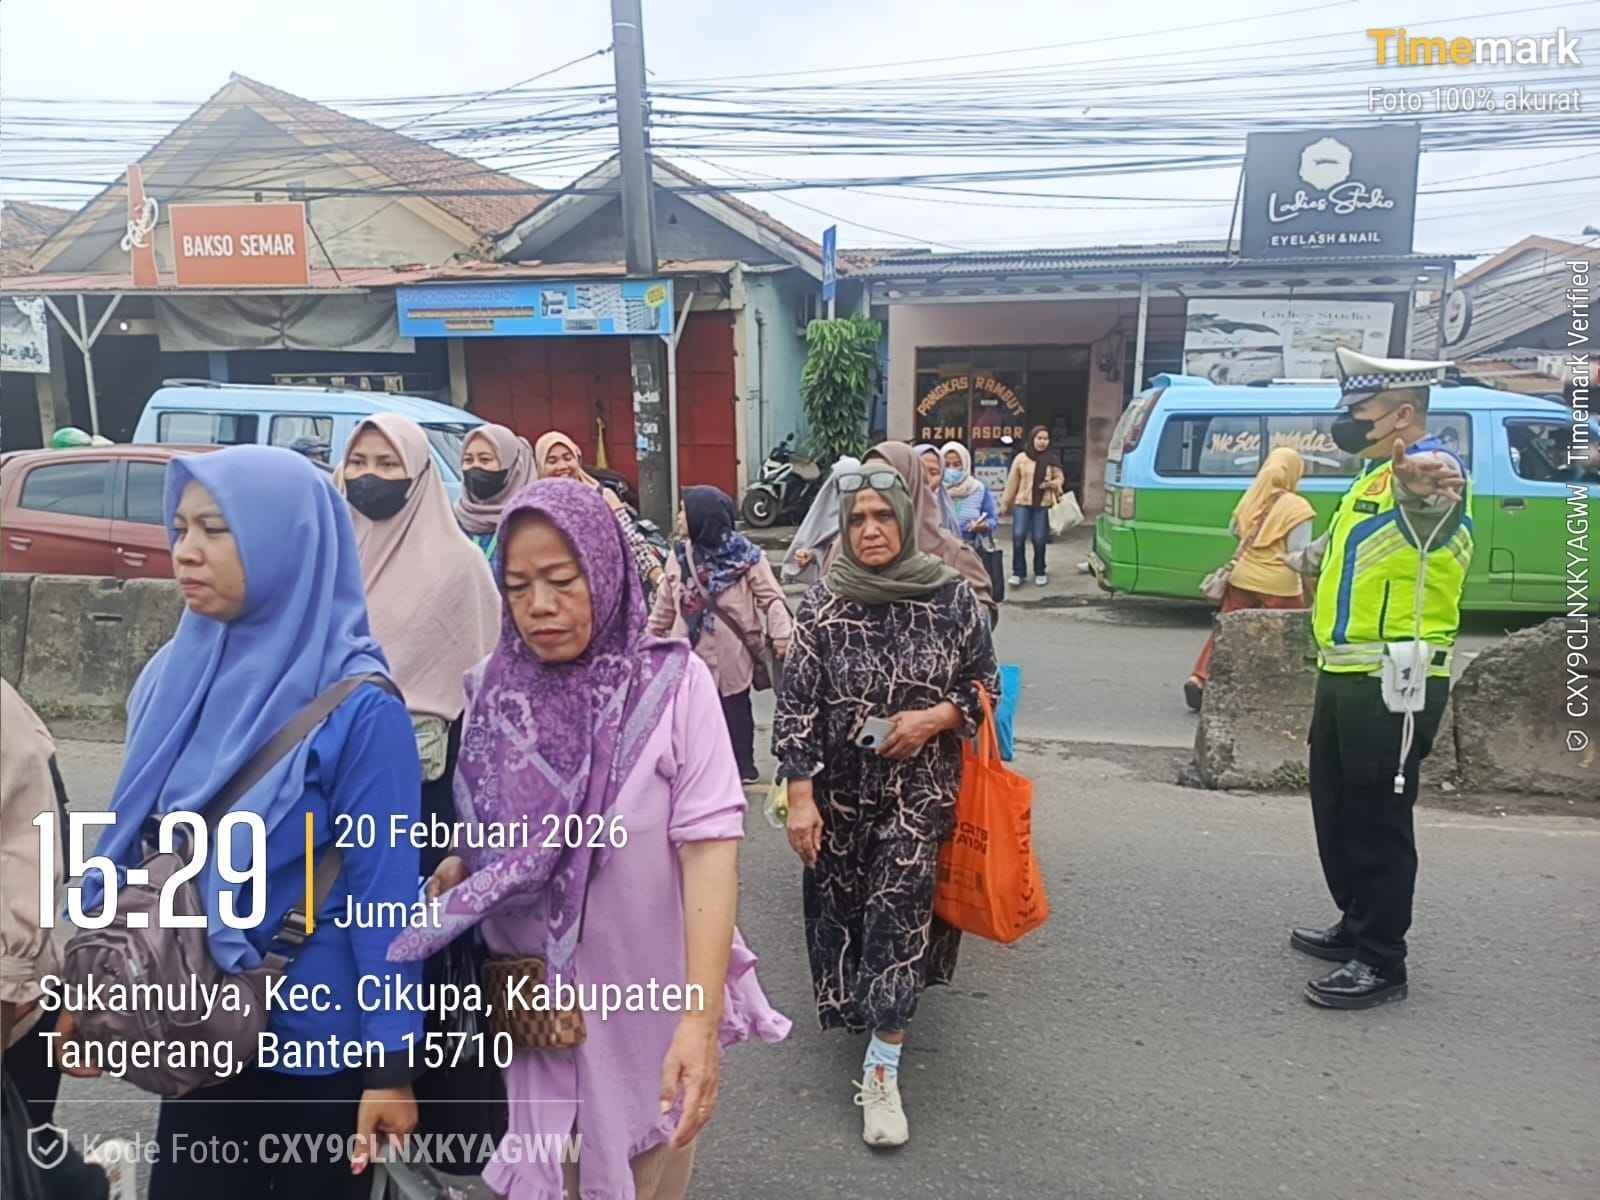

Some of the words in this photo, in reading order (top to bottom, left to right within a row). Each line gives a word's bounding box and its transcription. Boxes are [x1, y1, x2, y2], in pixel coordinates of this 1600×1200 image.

[1269, 190, 1328, 223] Ladies
[1329, 182, 1395, 214] Studio
[183, 235, 233, 257] BAKSO
[240, 233, 296, 257] SEMAR
[1271, 234, 1336, 246] EYELASH
[1349, 231, 1381, 243] NAIL
[917, 376, 969, 417] PANGKAS
[922, 427, 963, 440] AZMI
